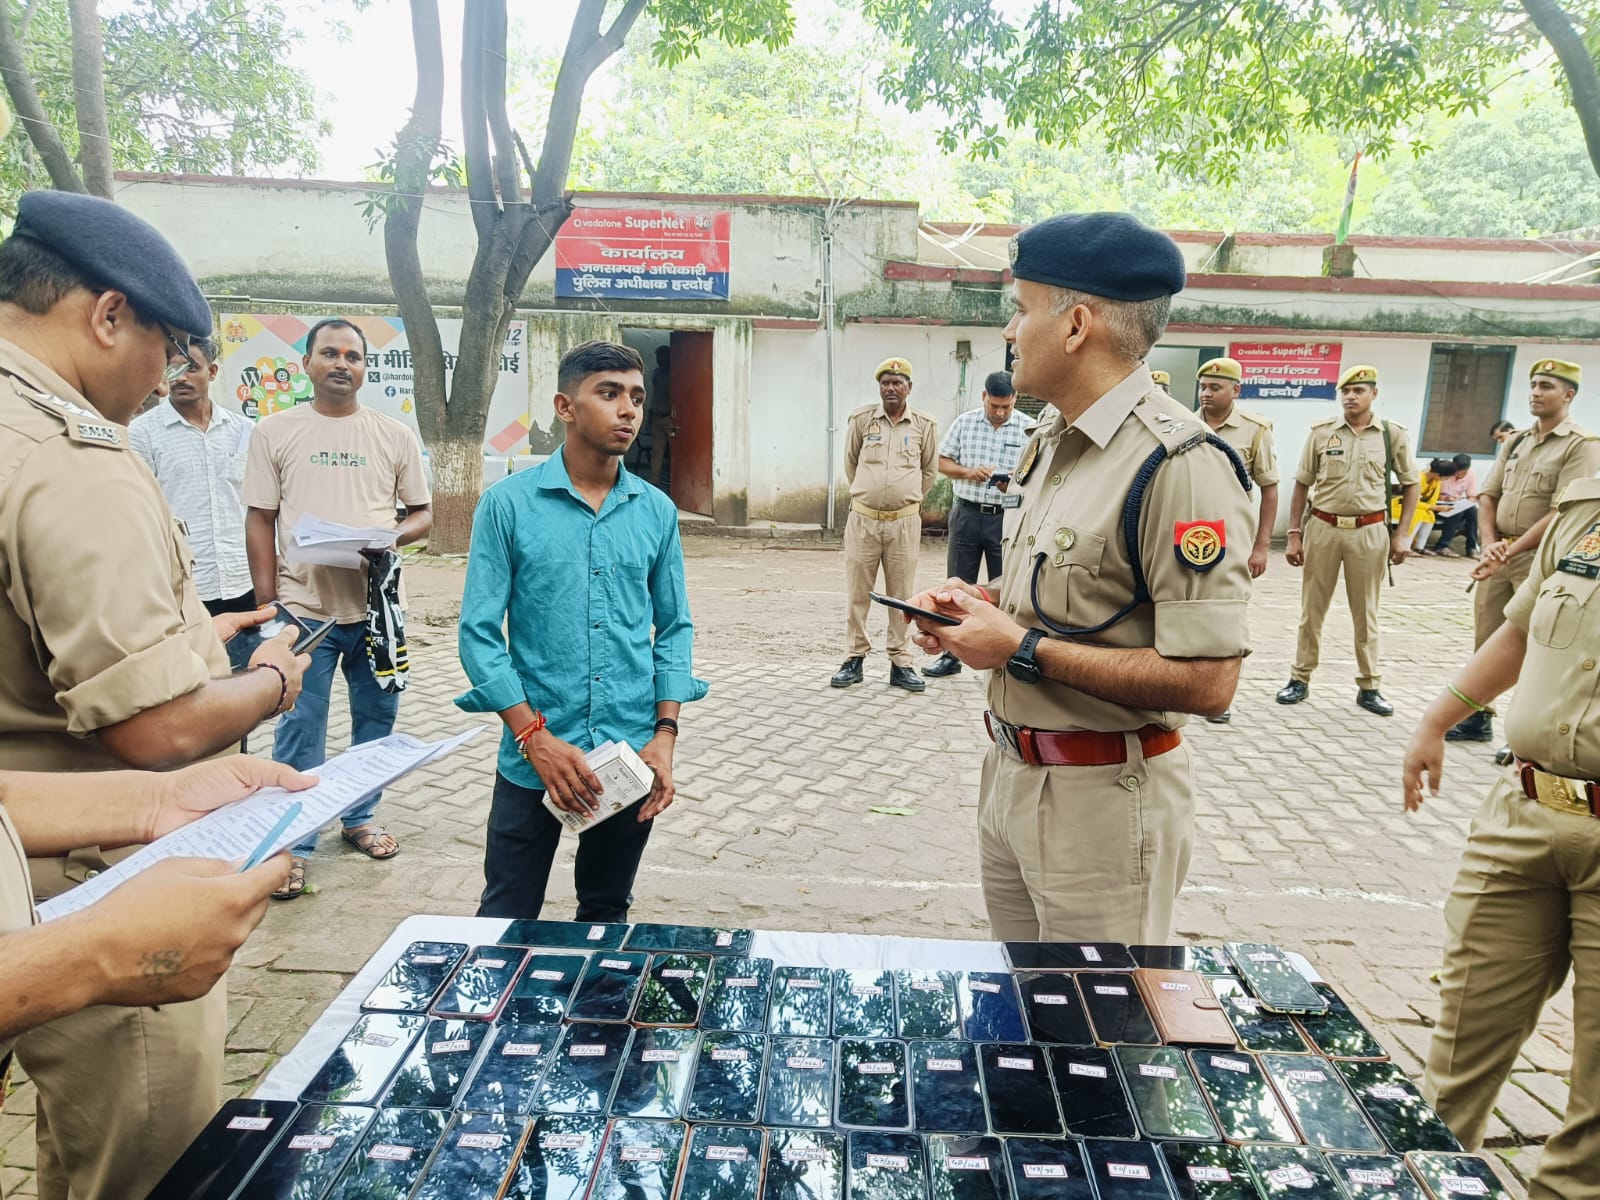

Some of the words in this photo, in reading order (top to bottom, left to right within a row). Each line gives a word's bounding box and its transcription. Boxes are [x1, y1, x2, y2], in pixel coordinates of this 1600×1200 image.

[583, 218, 622, 228] vodafone
[625, 216, 685, 231] SuperNet
[696, 217, 711, 228] 4G
[601, 246, 685, 259] कार्यालय
[578, 262, 647, 274] जनसम्पर्क
[649, 262, 707, 276] अधिकारी
[572, 274, 612, 292] पुलिस
[614, 275, 669, 289] अधीक्षक
[671, 276, 714, 293] हरदोई
[505, 328, 522, 341] 12
[1272, 346, 1313, 356] SuperNet
[1246, 365, 1319, 374] कार्यालय
[1259, 386, 1302, 397] हरदोई
